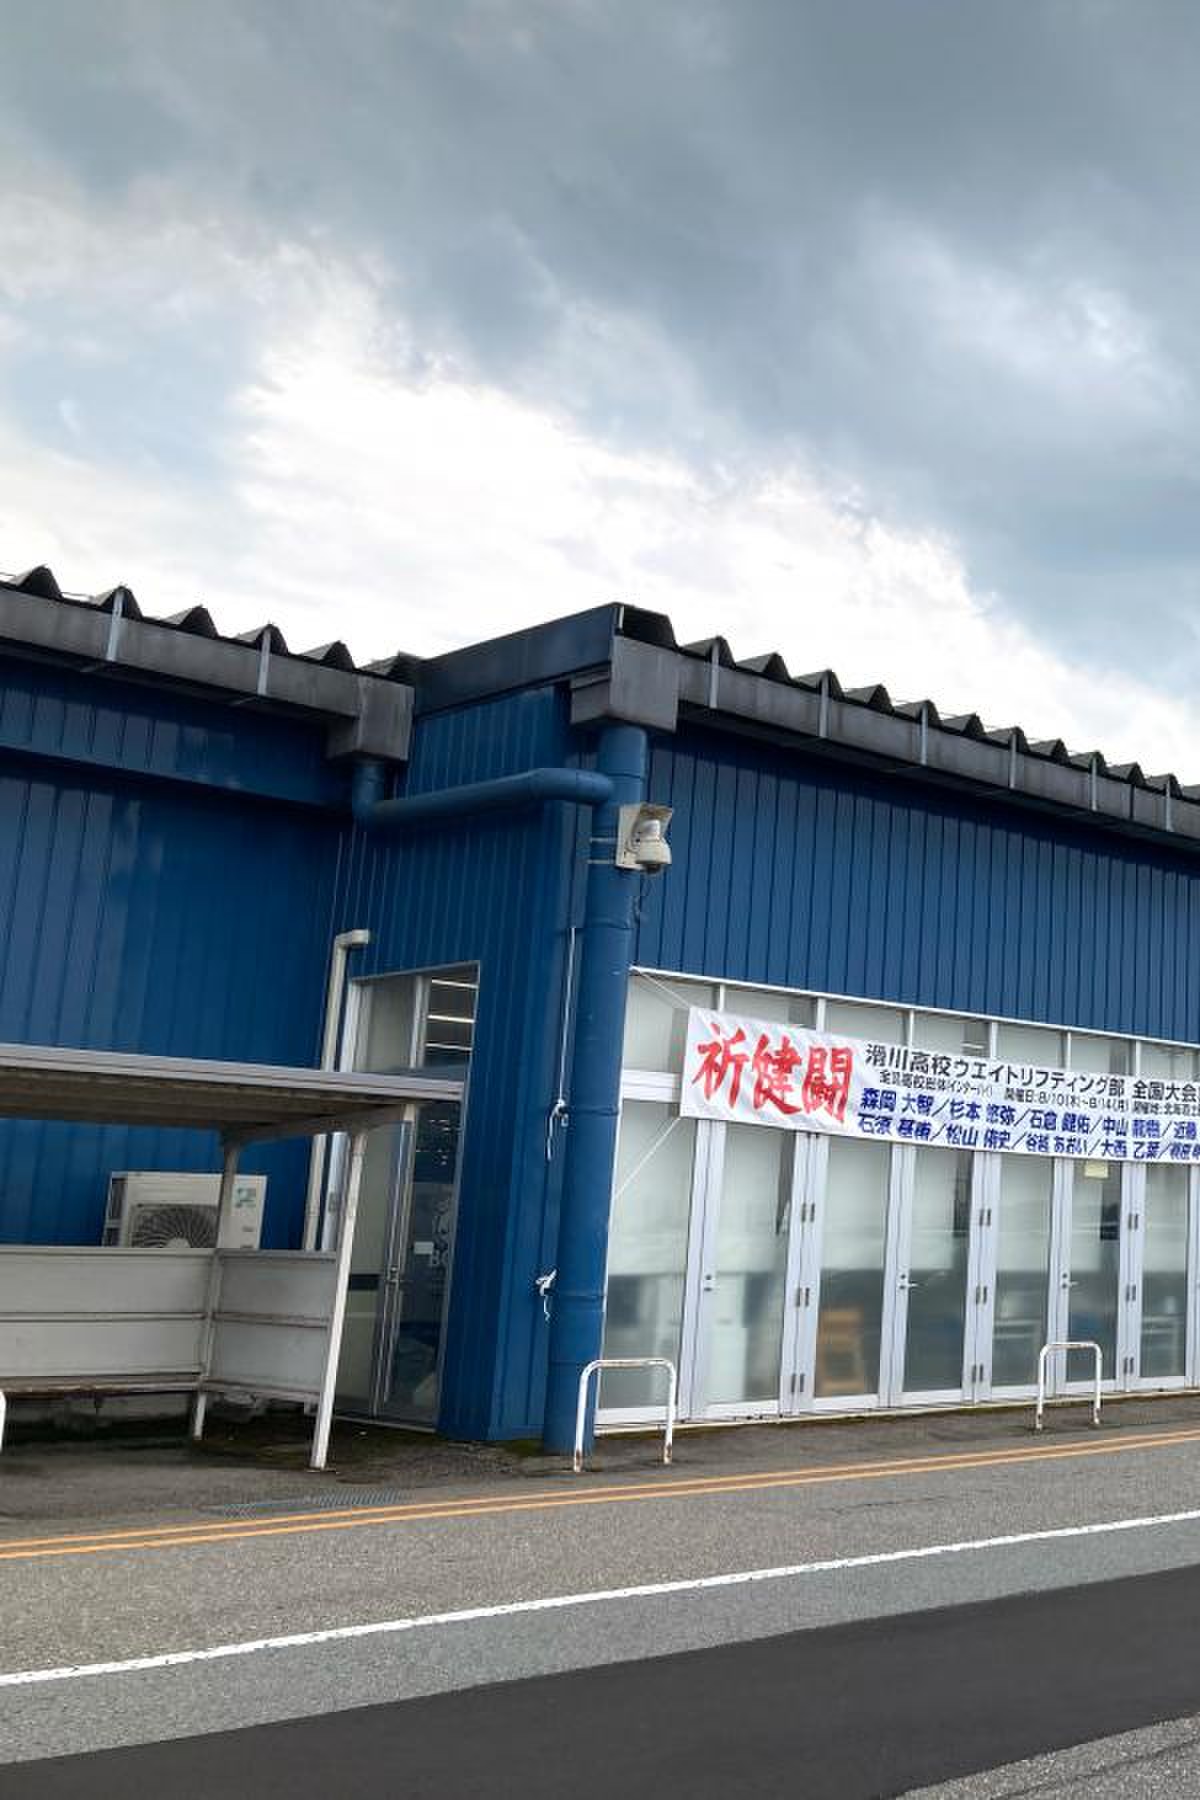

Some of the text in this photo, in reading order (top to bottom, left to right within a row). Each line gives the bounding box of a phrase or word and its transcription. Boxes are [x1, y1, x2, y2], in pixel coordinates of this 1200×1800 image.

[691, 1023, 854, 1124] 祈健闘
[864, 1043, 1125, 1098] 滑川高校ウエイトリフティング部
